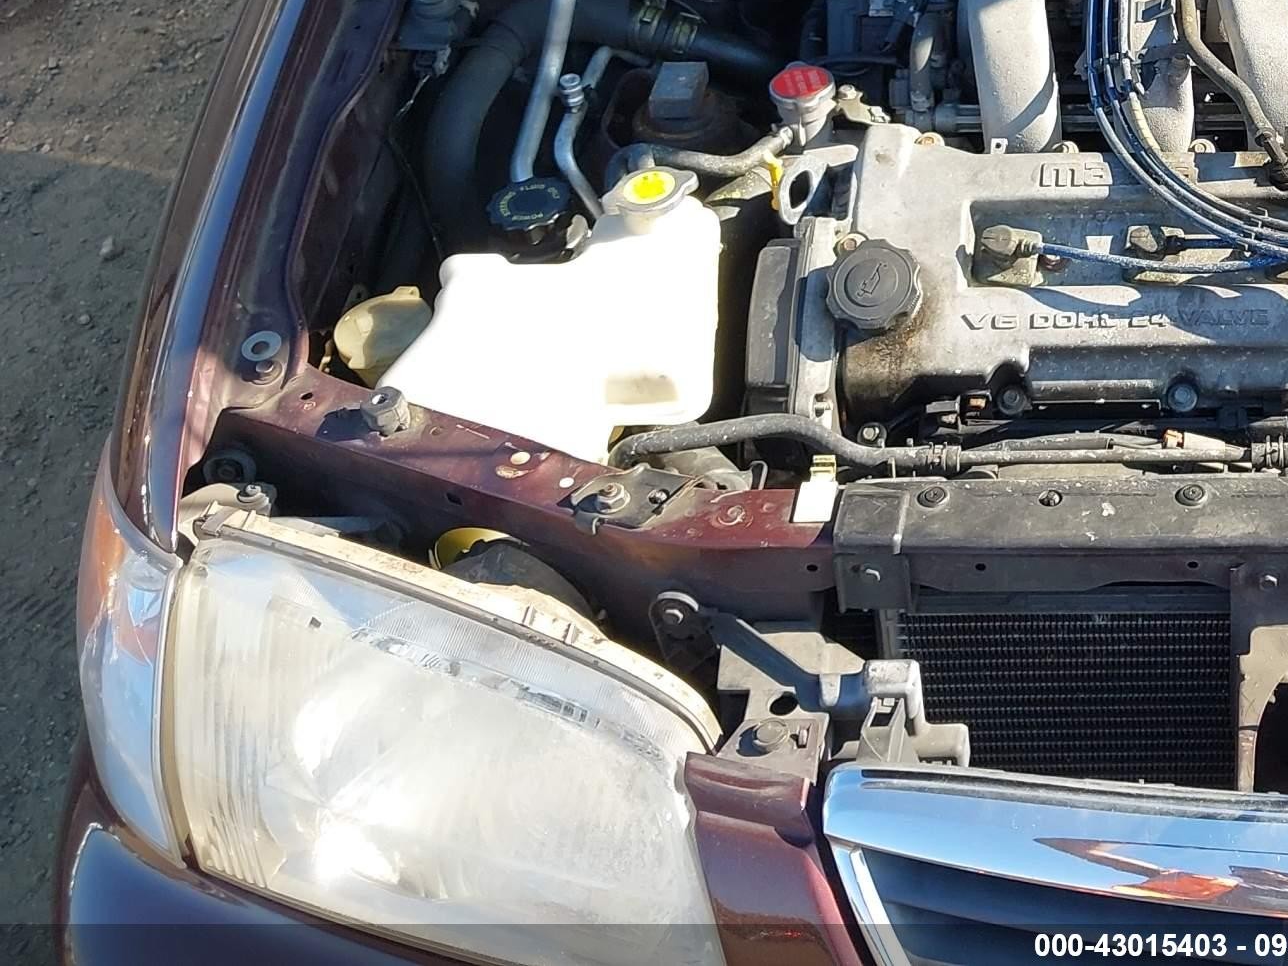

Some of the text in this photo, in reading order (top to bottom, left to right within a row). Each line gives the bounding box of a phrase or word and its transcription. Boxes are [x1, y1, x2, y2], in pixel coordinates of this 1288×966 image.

[960, 312, 1020, 331] V6
[1127, 312, 1172, 329] 24
[1178, 309, 1269, 325] VALVE
